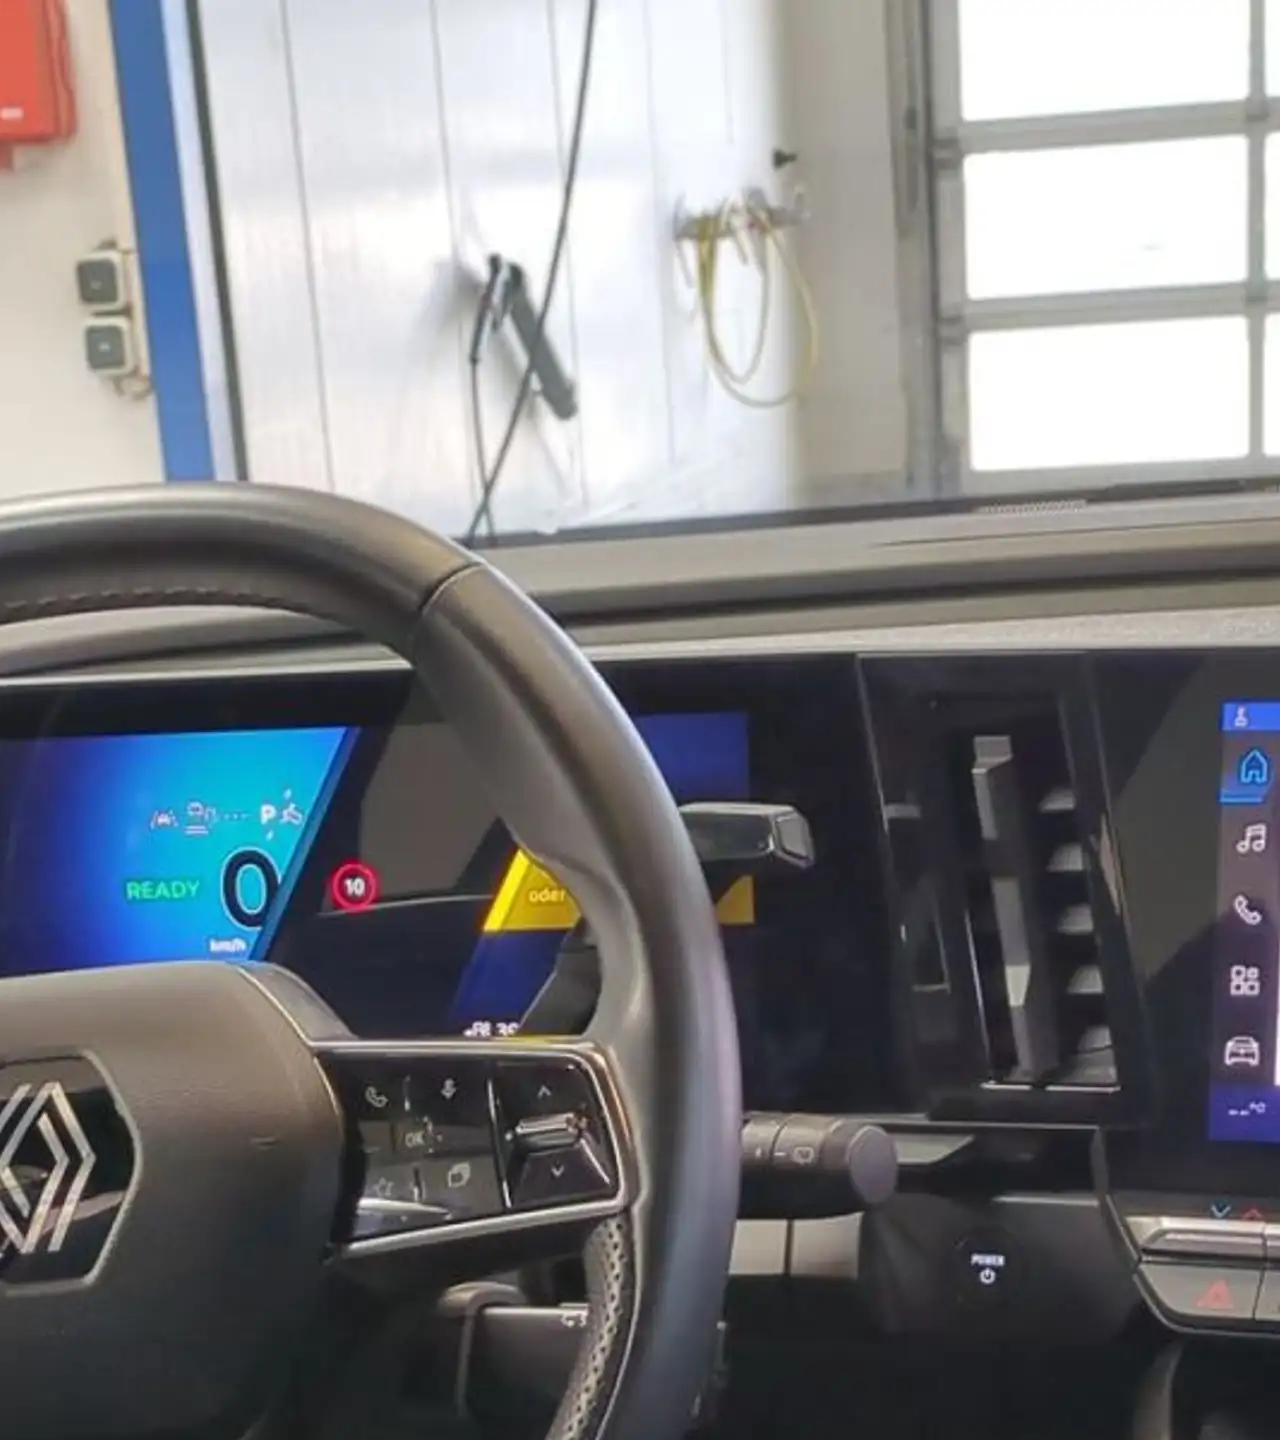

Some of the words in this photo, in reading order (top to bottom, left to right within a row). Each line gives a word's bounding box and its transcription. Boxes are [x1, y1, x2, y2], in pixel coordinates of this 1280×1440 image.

[260, 803, 278, 825] P
[126, 880, 200, 901] READY
[220, 846, 283, 929] 0
[344, 878, 365, 898] 10
[209, 938, 248, 953] km/h
[970, 1253, 1005, 1267] POWER
